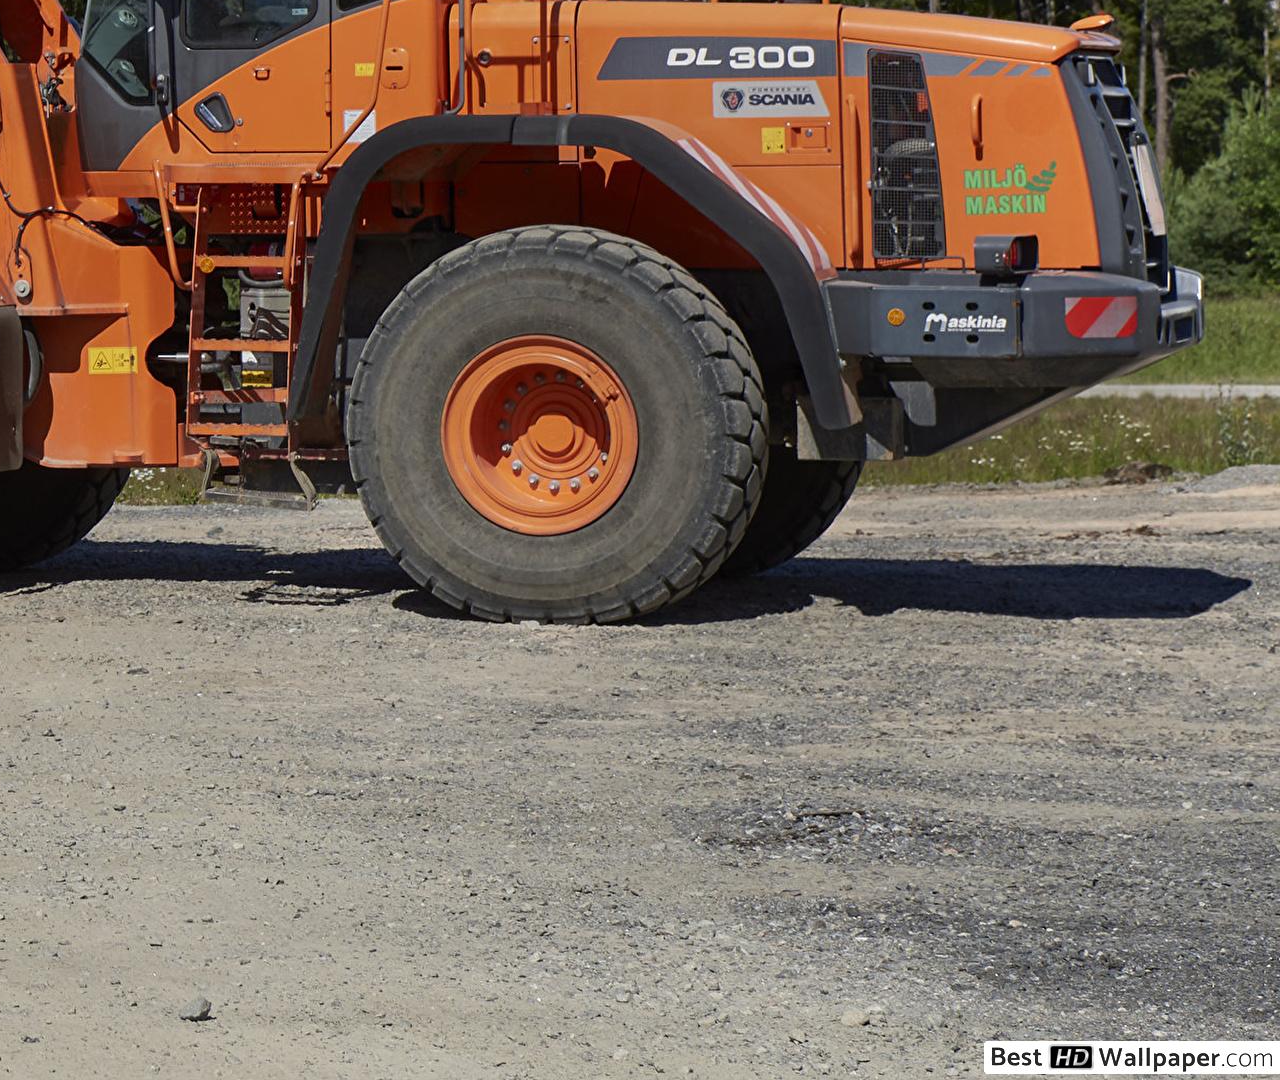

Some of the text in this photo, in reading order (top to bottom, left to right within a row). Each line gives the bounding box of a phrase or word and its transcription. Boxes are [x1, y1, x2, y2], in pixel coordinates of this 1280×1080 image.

[666, 45, 815, 69] DL 300
[748, 93, 815, 106] SCANIA
[964, 163, 1027, 189] MILJÖ
[965, 194, 1046, 216] MASKIN
